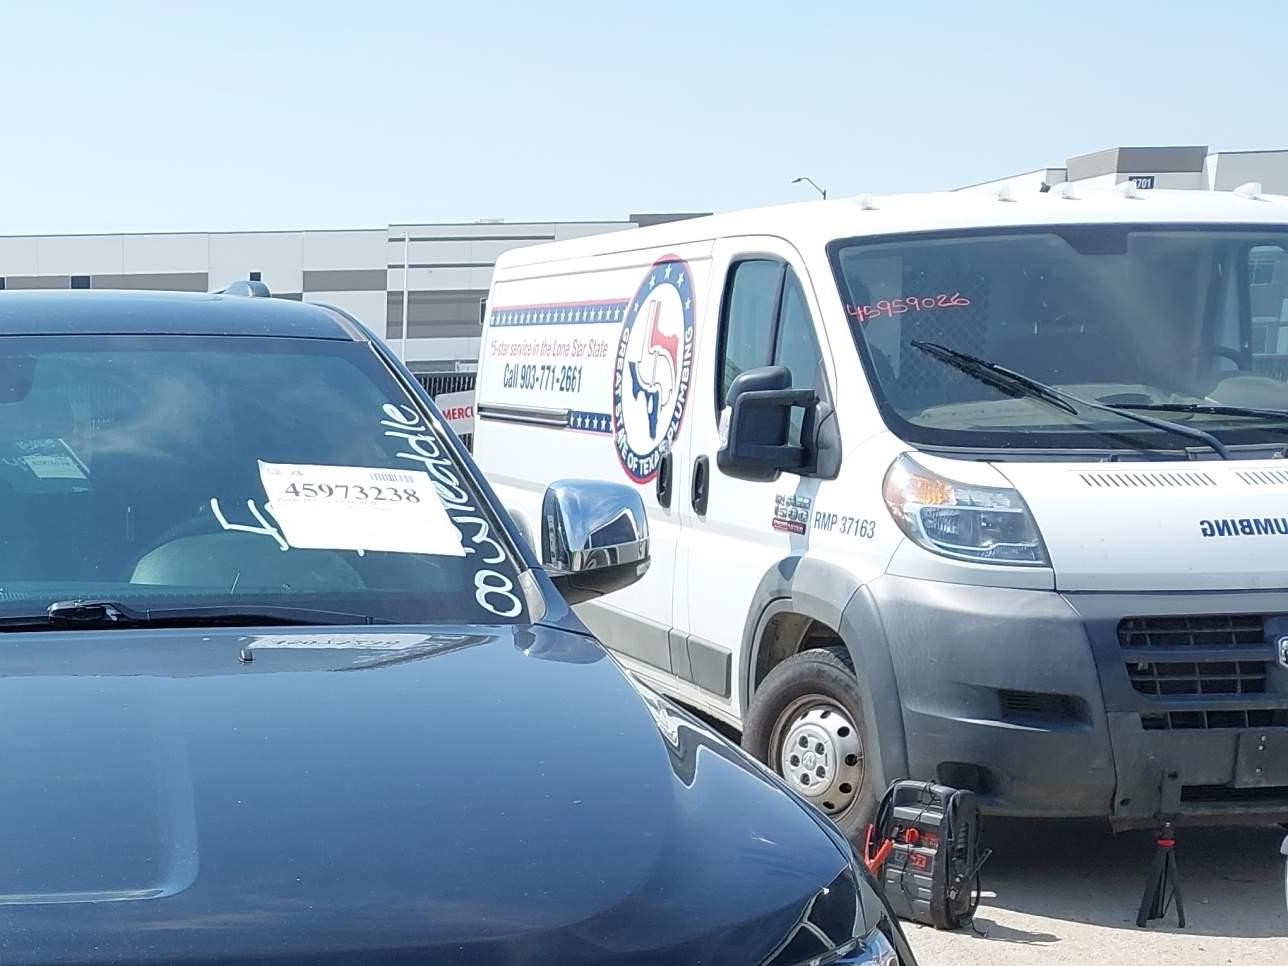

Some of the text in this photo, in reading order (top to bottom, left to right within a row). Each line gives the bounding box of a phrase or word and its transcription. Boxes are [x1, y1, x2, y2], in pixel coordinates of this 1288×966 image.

[1132, 178, 1152, 189] 701
[846, 292, 971, 322] 45959026
[510, 340, 532, 357] service
[533, 339, 540, 356] in
[541, 339, 552, 357] the
[552, 339, 570, 357] Lone
[571, 338, 587, 358] Star
[587, 338, 608, 358] State
[503, 363, 582, 392] Call 903-771-2661
[615, 327, 630, 397] GREAT
[627, 452, 639, 472] OF
[667, 325, 693, 445] PLUMBING
[285, 482, 421, 504] 45973238
[814, 511, 838, 532] RMP
[840, 516, 876, 539] 37163
